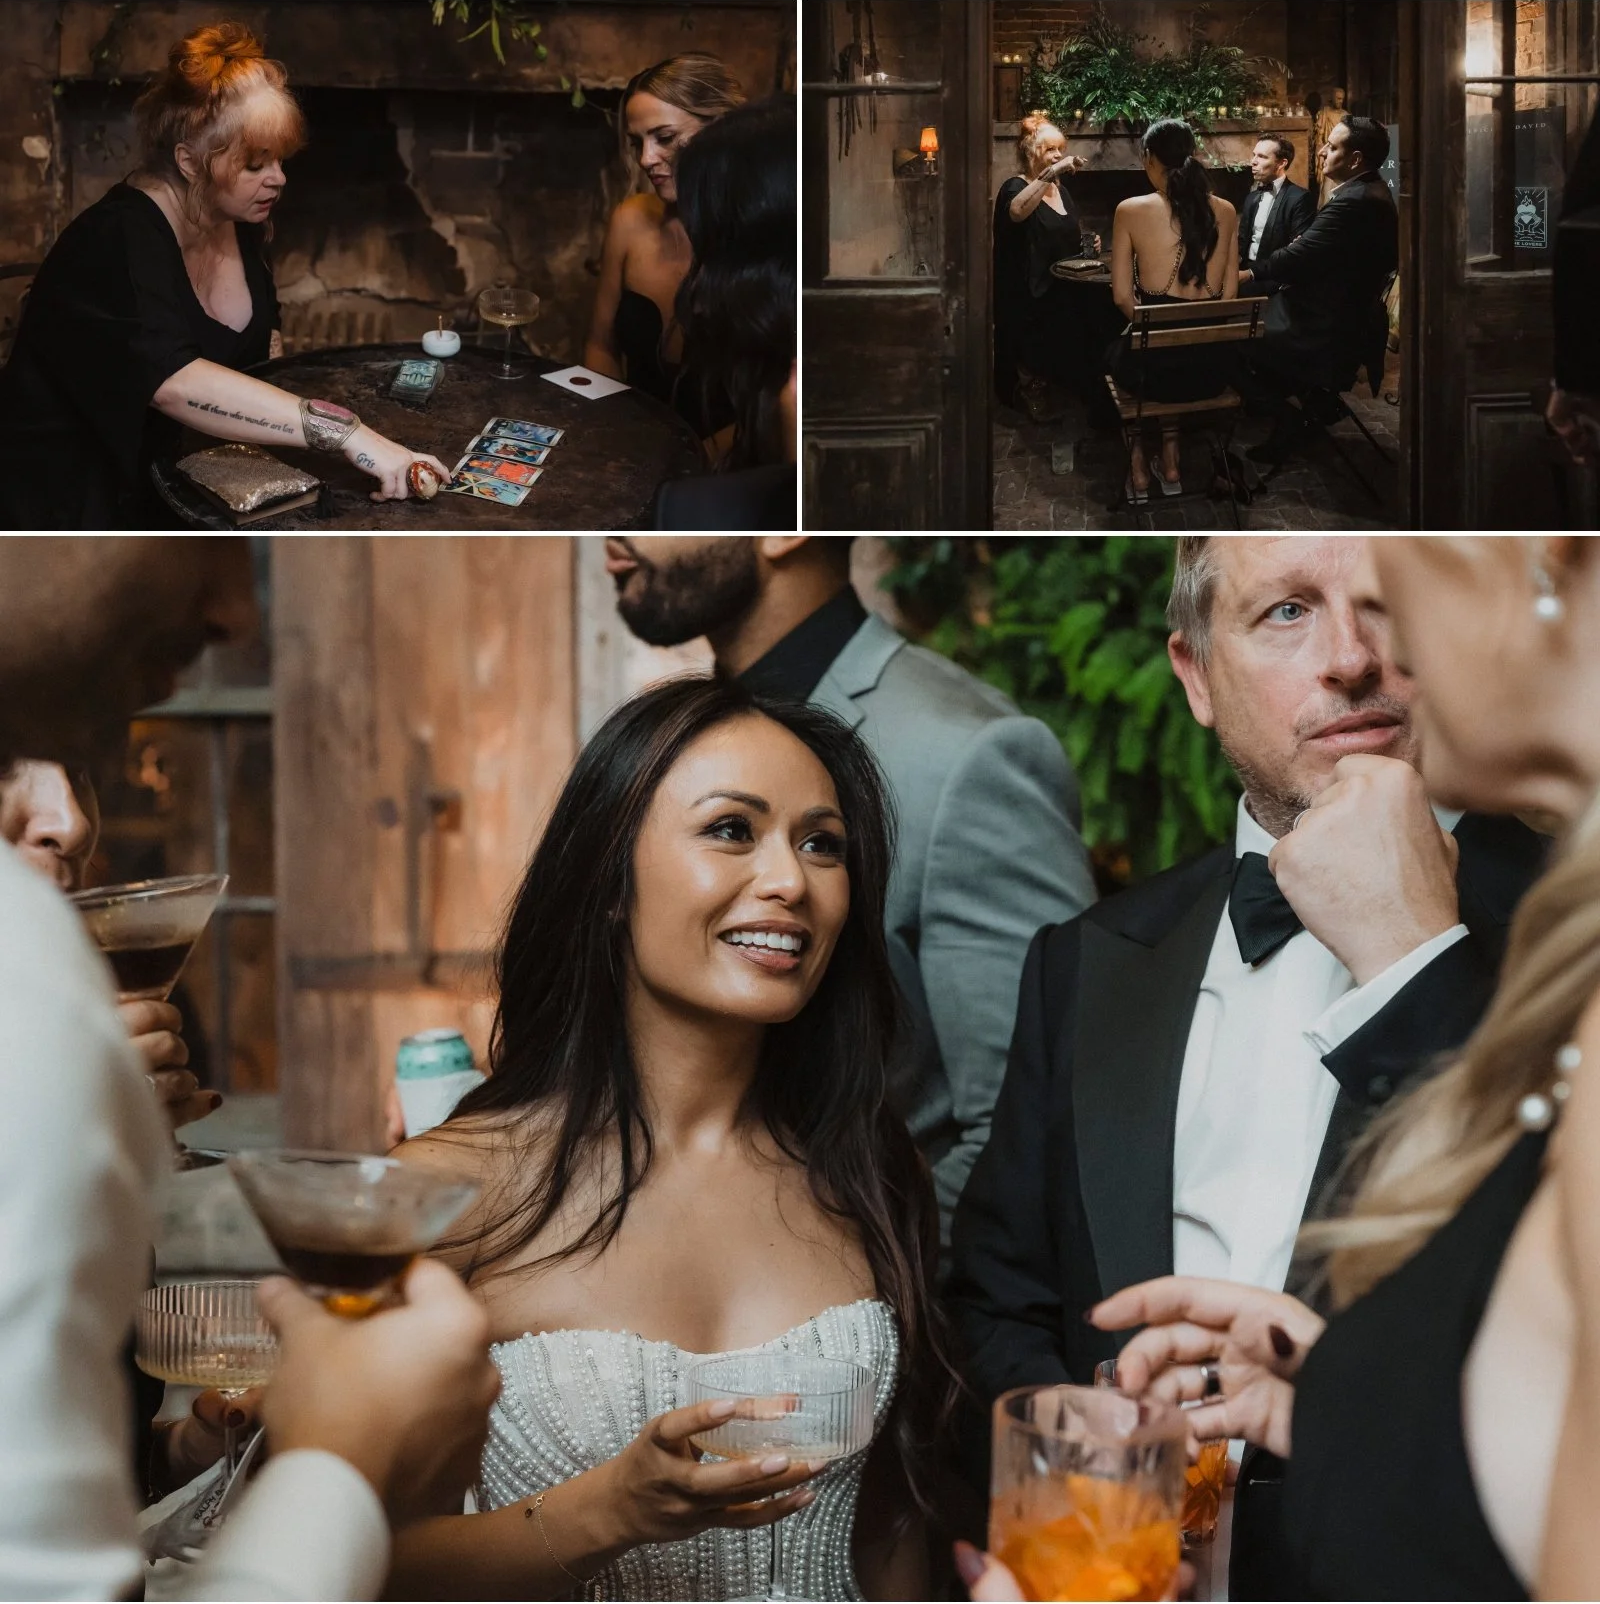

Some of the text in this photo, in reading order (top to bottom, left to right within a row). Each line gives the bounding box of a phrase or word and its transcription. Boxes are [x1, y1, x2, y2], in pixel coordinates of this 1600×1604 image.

[1515, 122, 1546, 130] DAVID
[200, 403, 211, 411] all
[211, 405, 228, 416] those
[229, 411, 243, 420] who
[244, 416, 270, 427] wander
[270, 422, 282, 431] are
[282, 424, 294, 434] lost
[356, 452, 376, 469] Gris
[193, 1496, 216, 1520] RALPH
